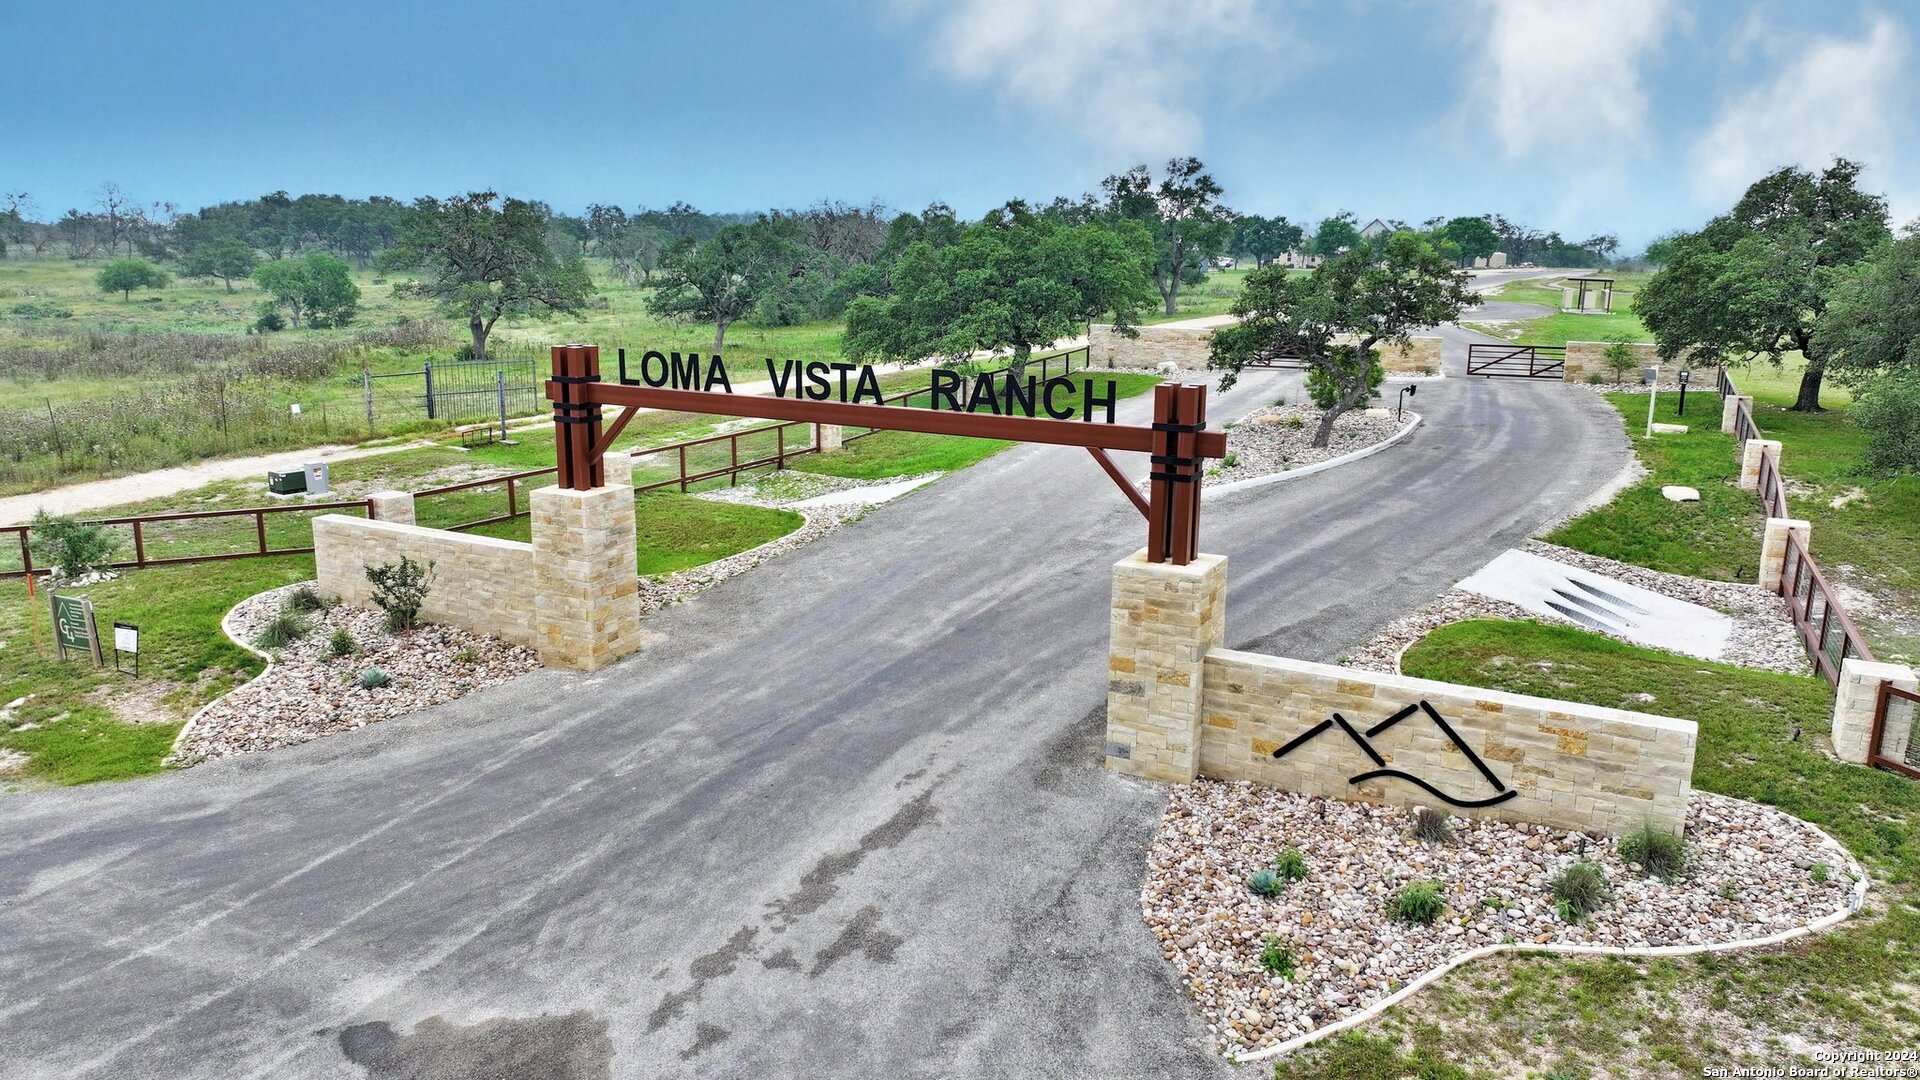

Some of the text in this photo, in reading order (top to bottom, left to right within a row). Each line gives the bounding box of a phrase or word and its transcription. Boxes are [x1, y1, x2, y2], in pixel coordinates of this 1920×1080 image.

[619, 349, 1117, 424] LOMA VISTA RANCH
